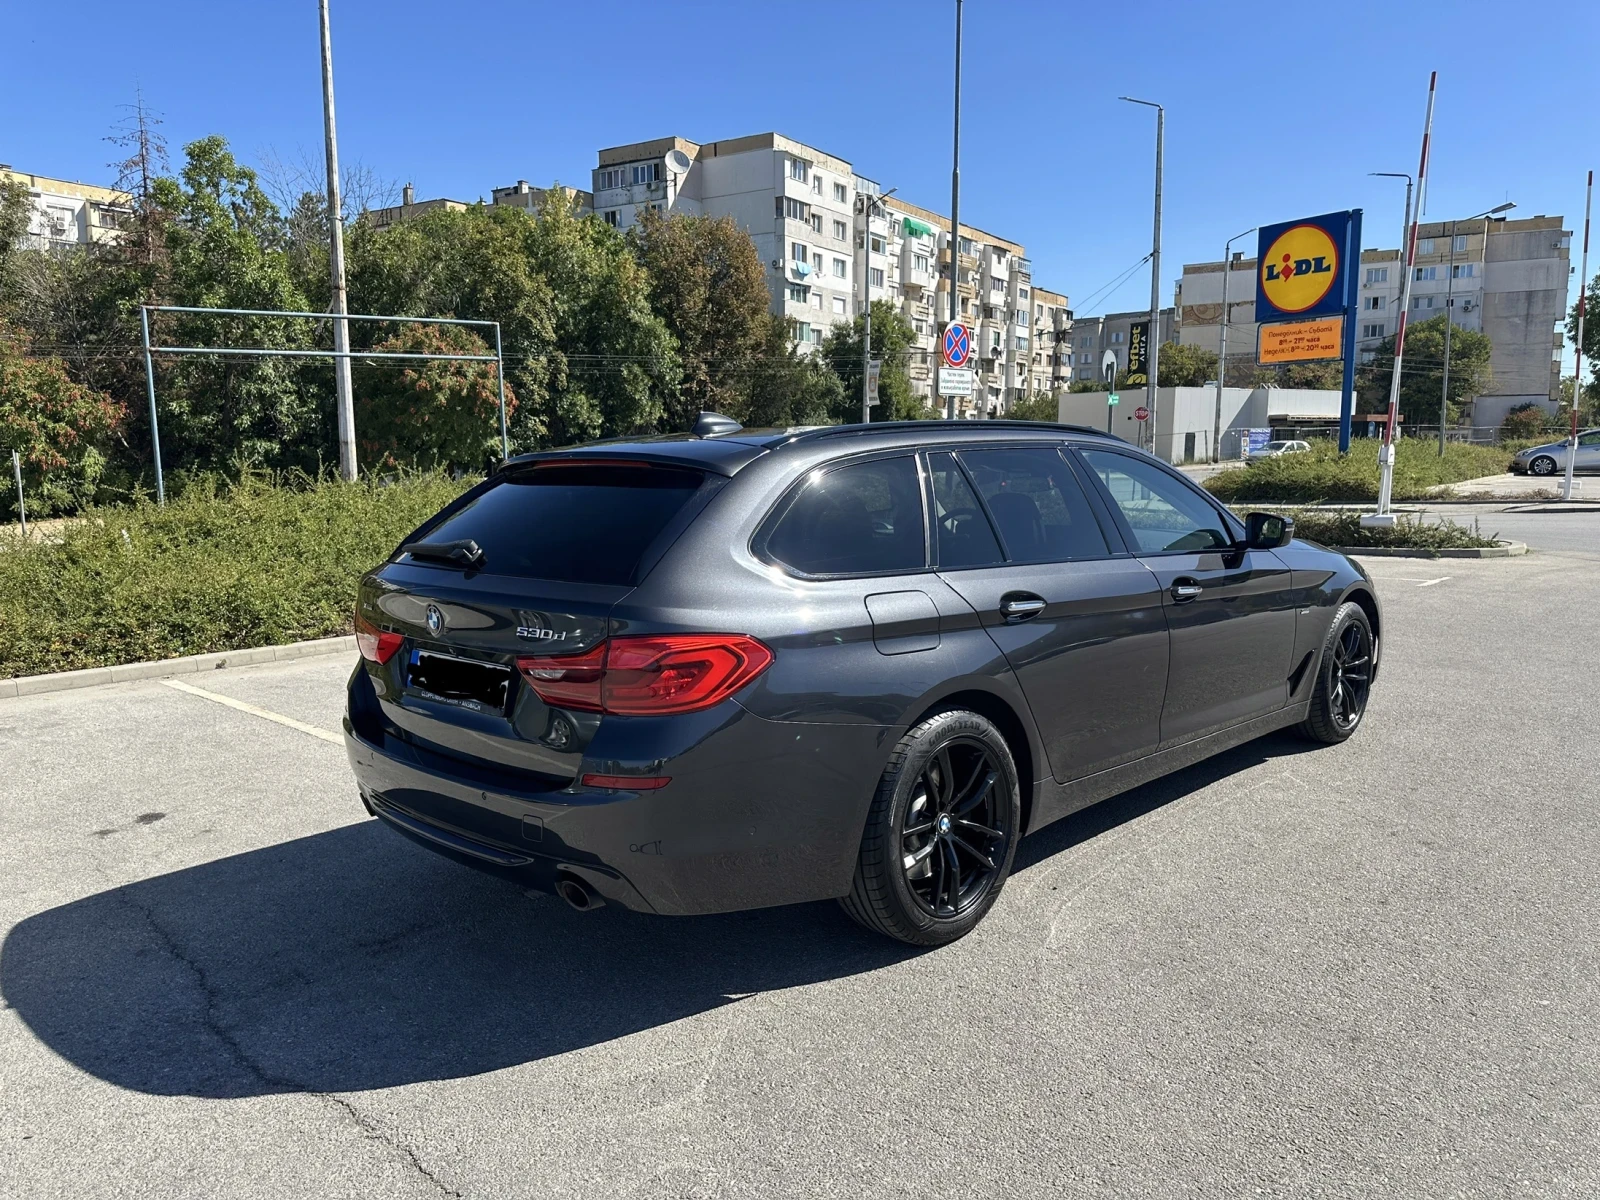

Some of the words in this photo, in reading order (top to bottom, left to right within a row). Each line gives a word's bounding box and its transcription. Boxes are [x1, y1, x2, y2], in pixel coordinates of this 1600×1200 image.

[1130, 326, 1141, 370] efbet
[516, 626, 567, 641] 530d
[929, 720, 980, 746] GOODYEAR
